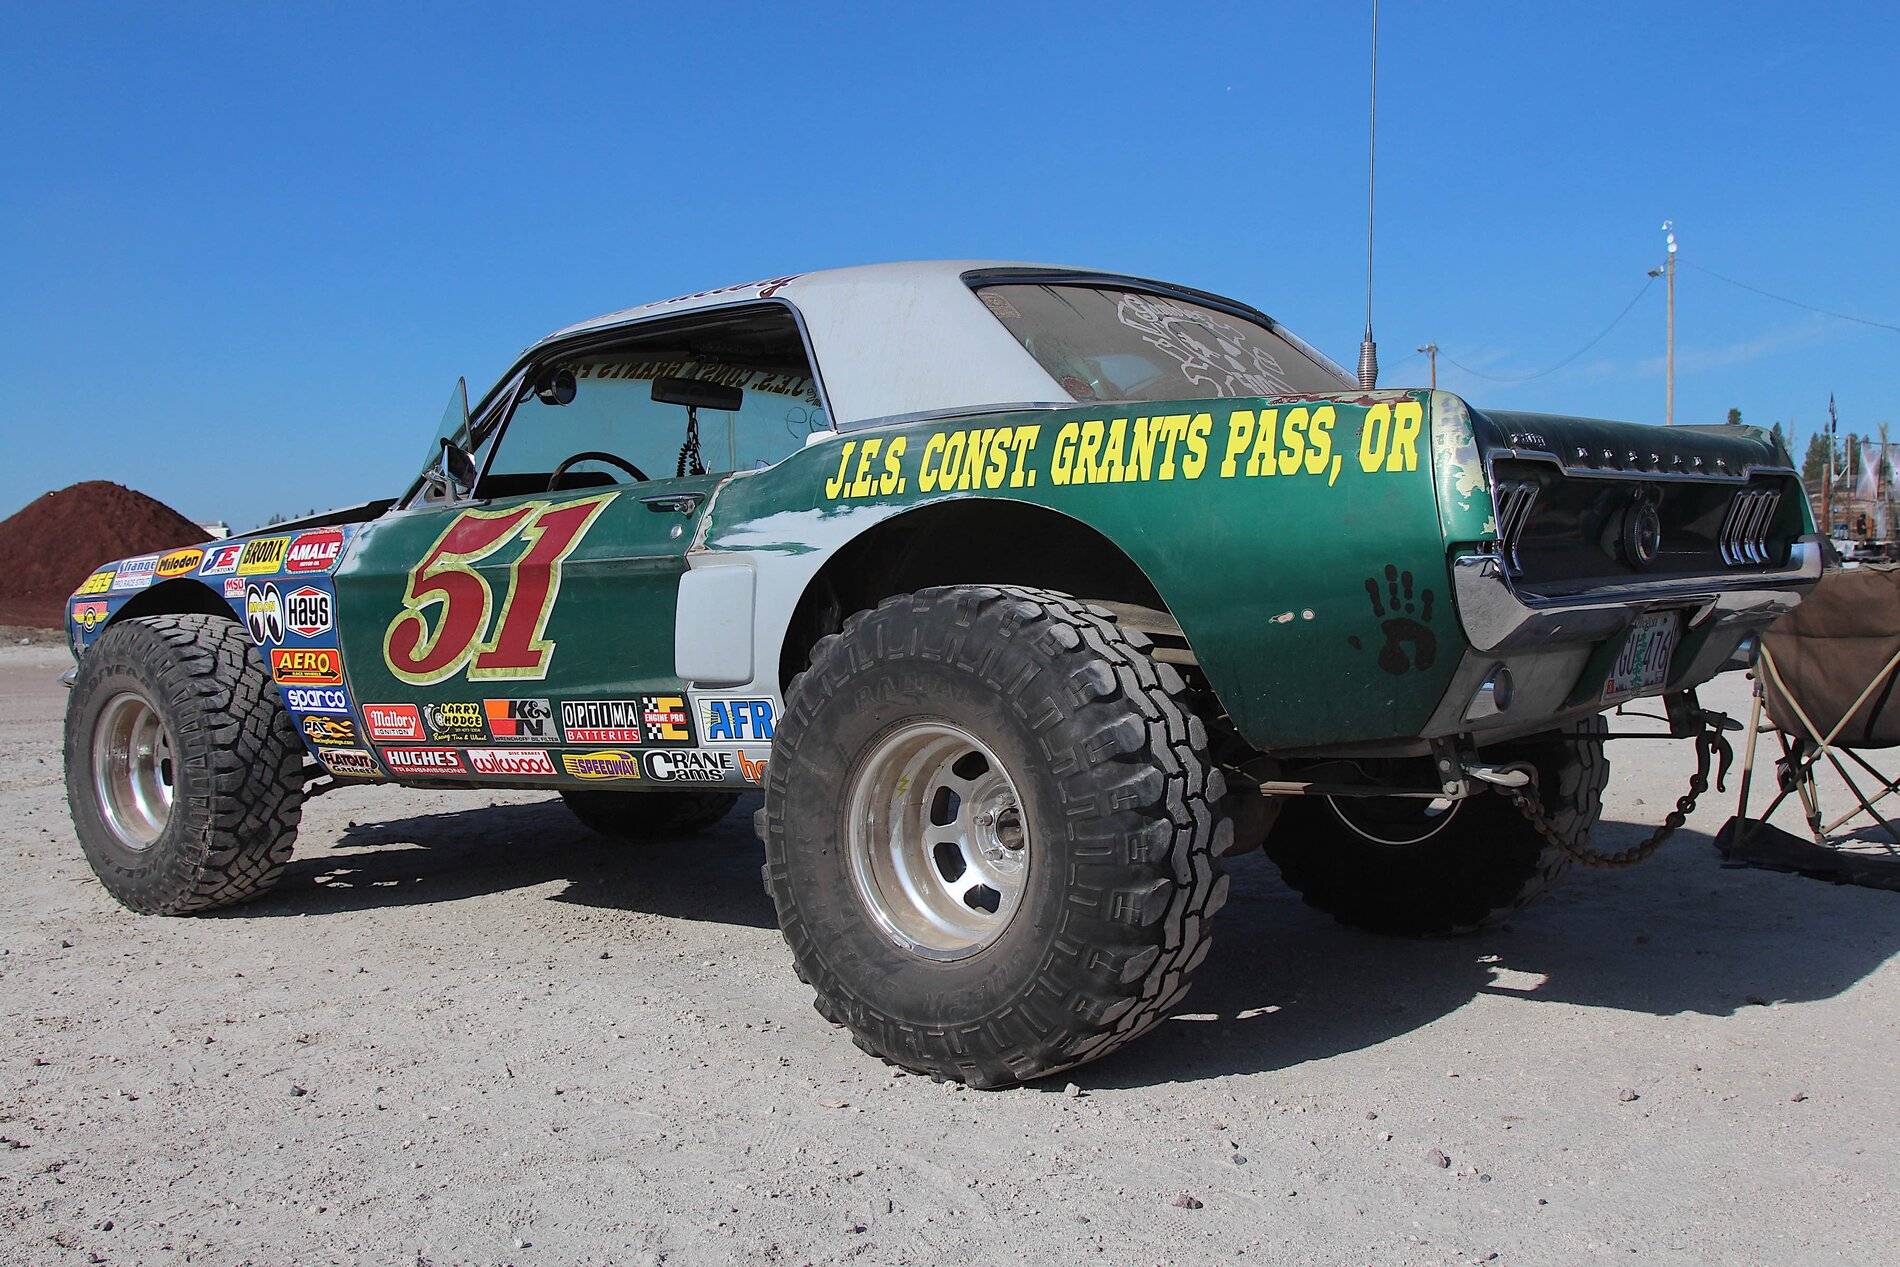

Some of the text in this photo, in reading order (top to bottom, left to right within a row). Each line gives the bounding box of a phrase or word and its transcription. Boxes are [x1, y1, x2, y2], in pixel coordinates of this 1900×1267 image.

[825, 401, 1423, 500] J.E.S. CONST. GRANTS PASS, OR
[243, 540, 286, 565] BRODIX
[287, 542, 341, 562] AMALIE
[159, 555, 200, 572] Milodon
[382, 491, 622, 686] 51
[288, 597, 329, 626] Hays
[279, 652, 330, 673] AERO
[288, 690, 346, 711] sparco
[442, 704, 478, 715] LARRY
[371, 711, 416, 731] Mallory
[444, 715, 481, 726] HODGE
[563, 701, 637, 729] OPTIMA
[645, 712, 684, 722] ENGINE PRO
[709, 700, 774, 739] AFR
[568, 731, 639, 742] BATTERIES
[386, 751, 459, 766] HUGHES
[473, 751, 554, 773] wilwood
[577, 759, 635, 776] SPEEDWAY
